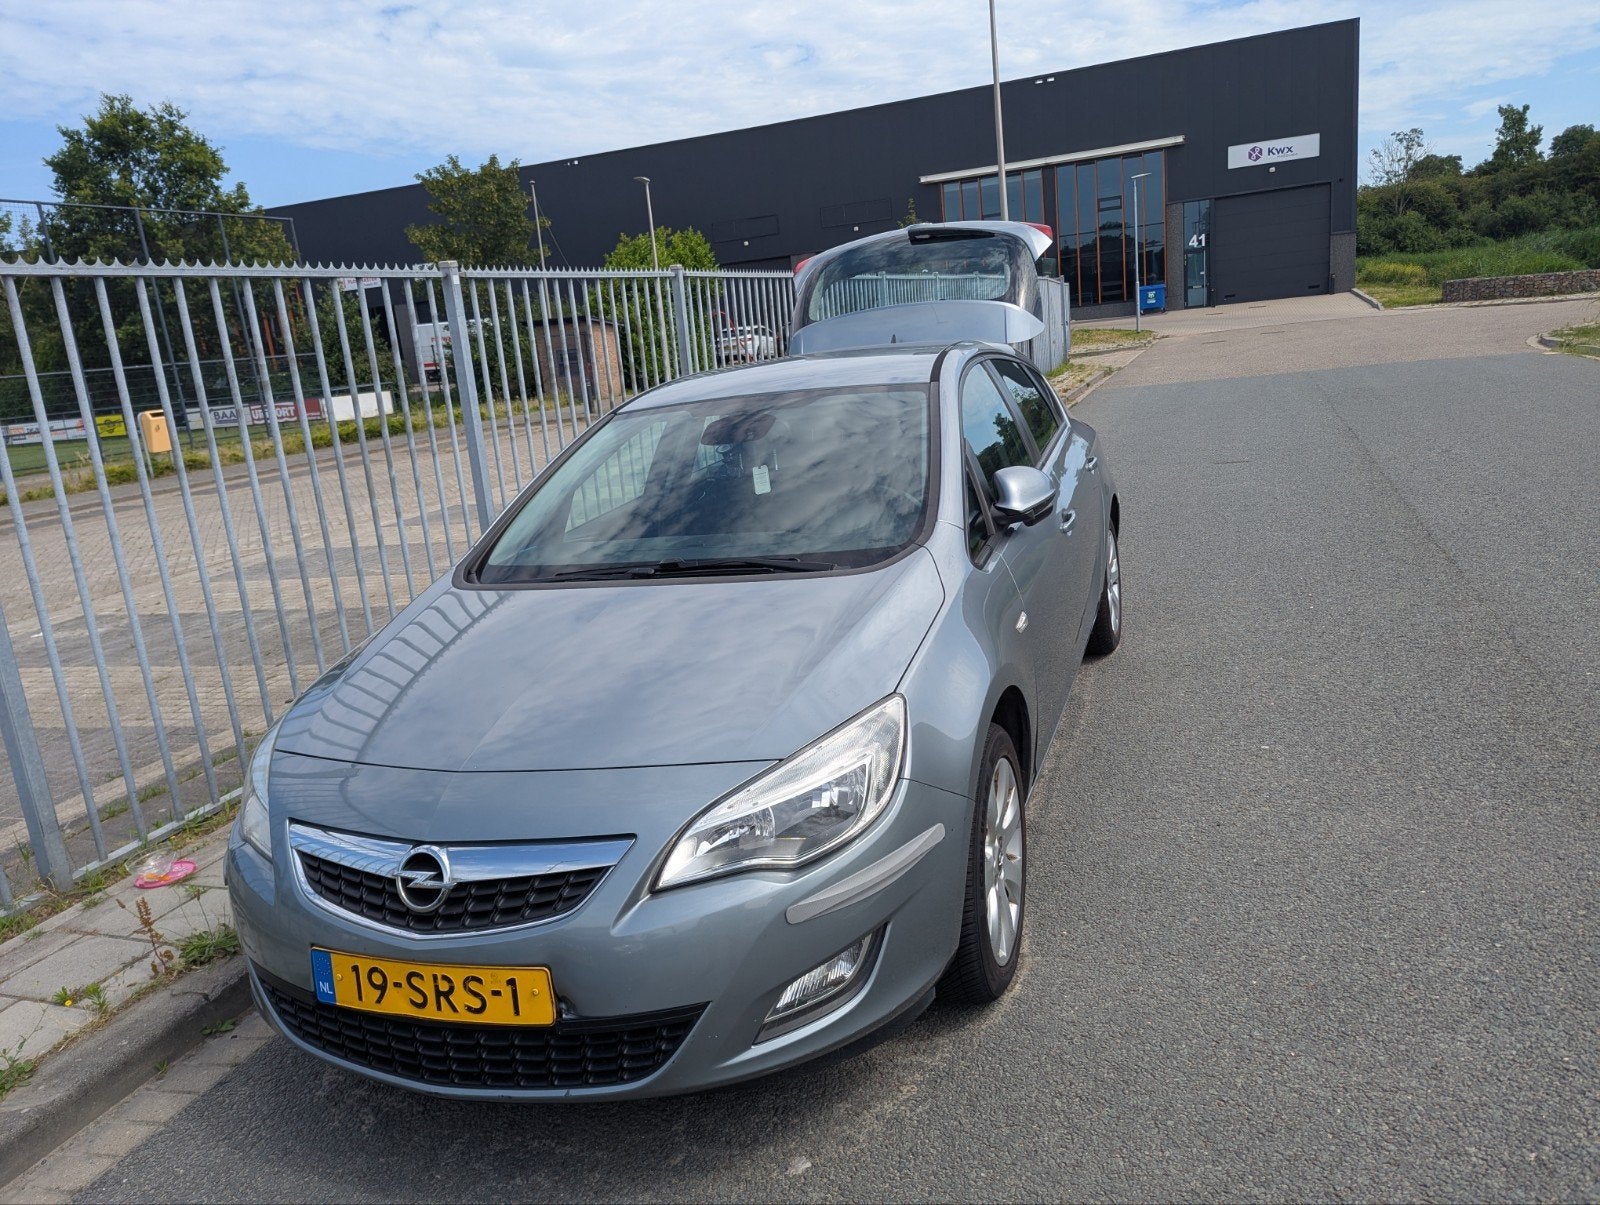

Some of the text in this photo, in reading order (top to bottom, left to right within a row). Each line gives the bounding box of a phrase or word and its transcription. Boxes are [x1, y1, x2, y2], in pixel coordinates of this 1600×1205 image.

[1188, 233, 1206, 248] 41
[319, 981, 334, 995] NL
[351, 964, 521, 1017] 19-SRS-1
